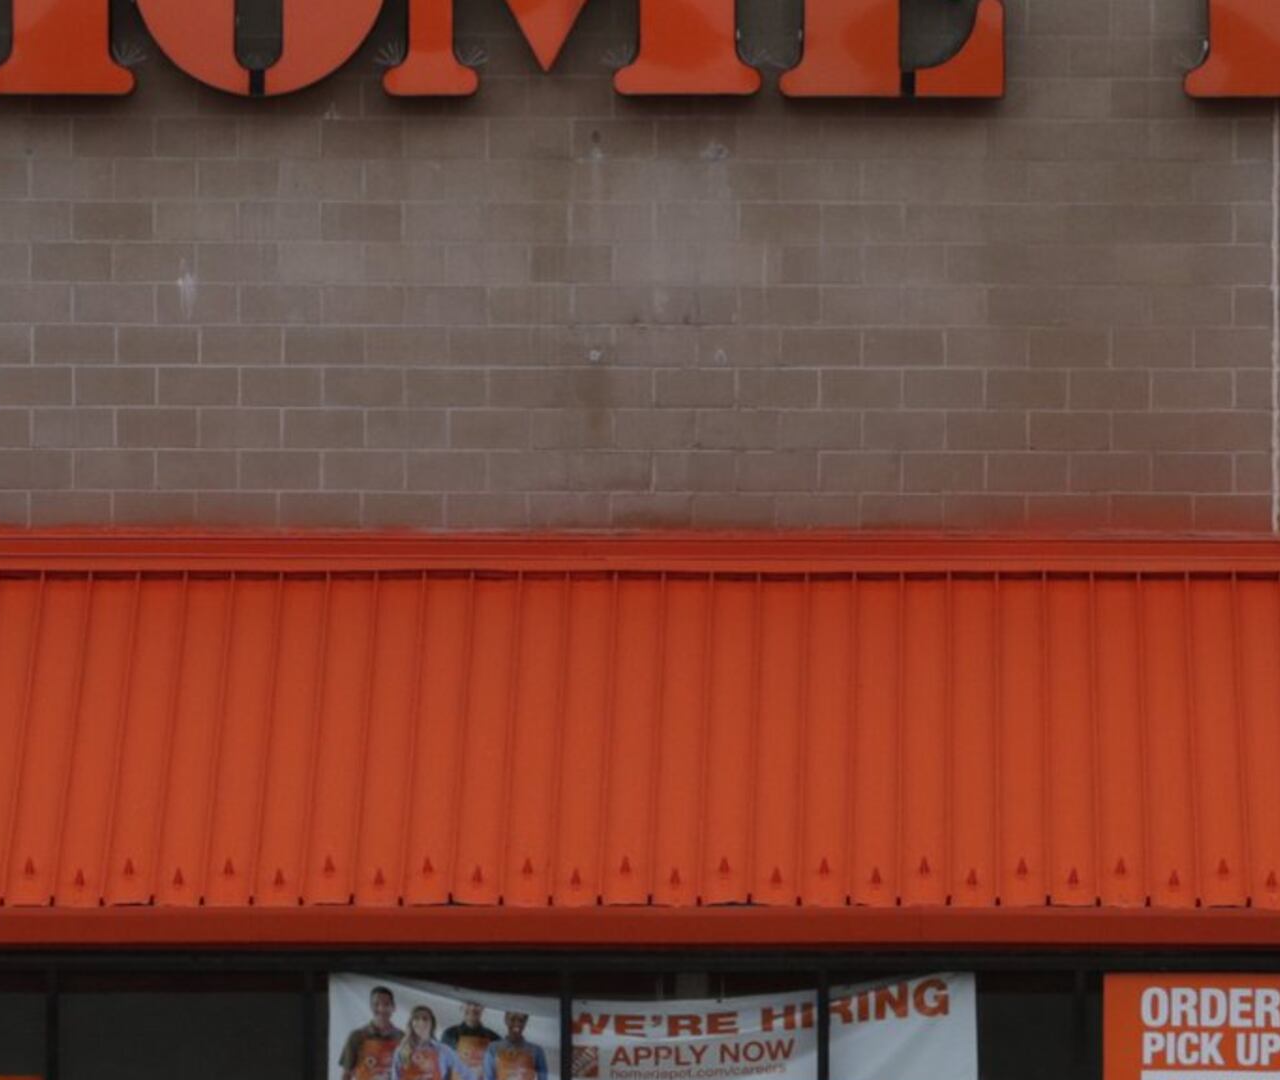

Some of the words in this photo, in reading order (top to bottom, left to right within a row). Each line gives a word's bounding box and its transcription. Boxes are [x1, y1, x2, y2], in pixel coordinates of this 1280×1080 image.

[761, 979, 951, 1032] HIRING
[610, 1044, 708, 1068] APPLY
[719, 1037, 795, 1063] NOW
[1143, 1031, 1226, 1066] PICK
